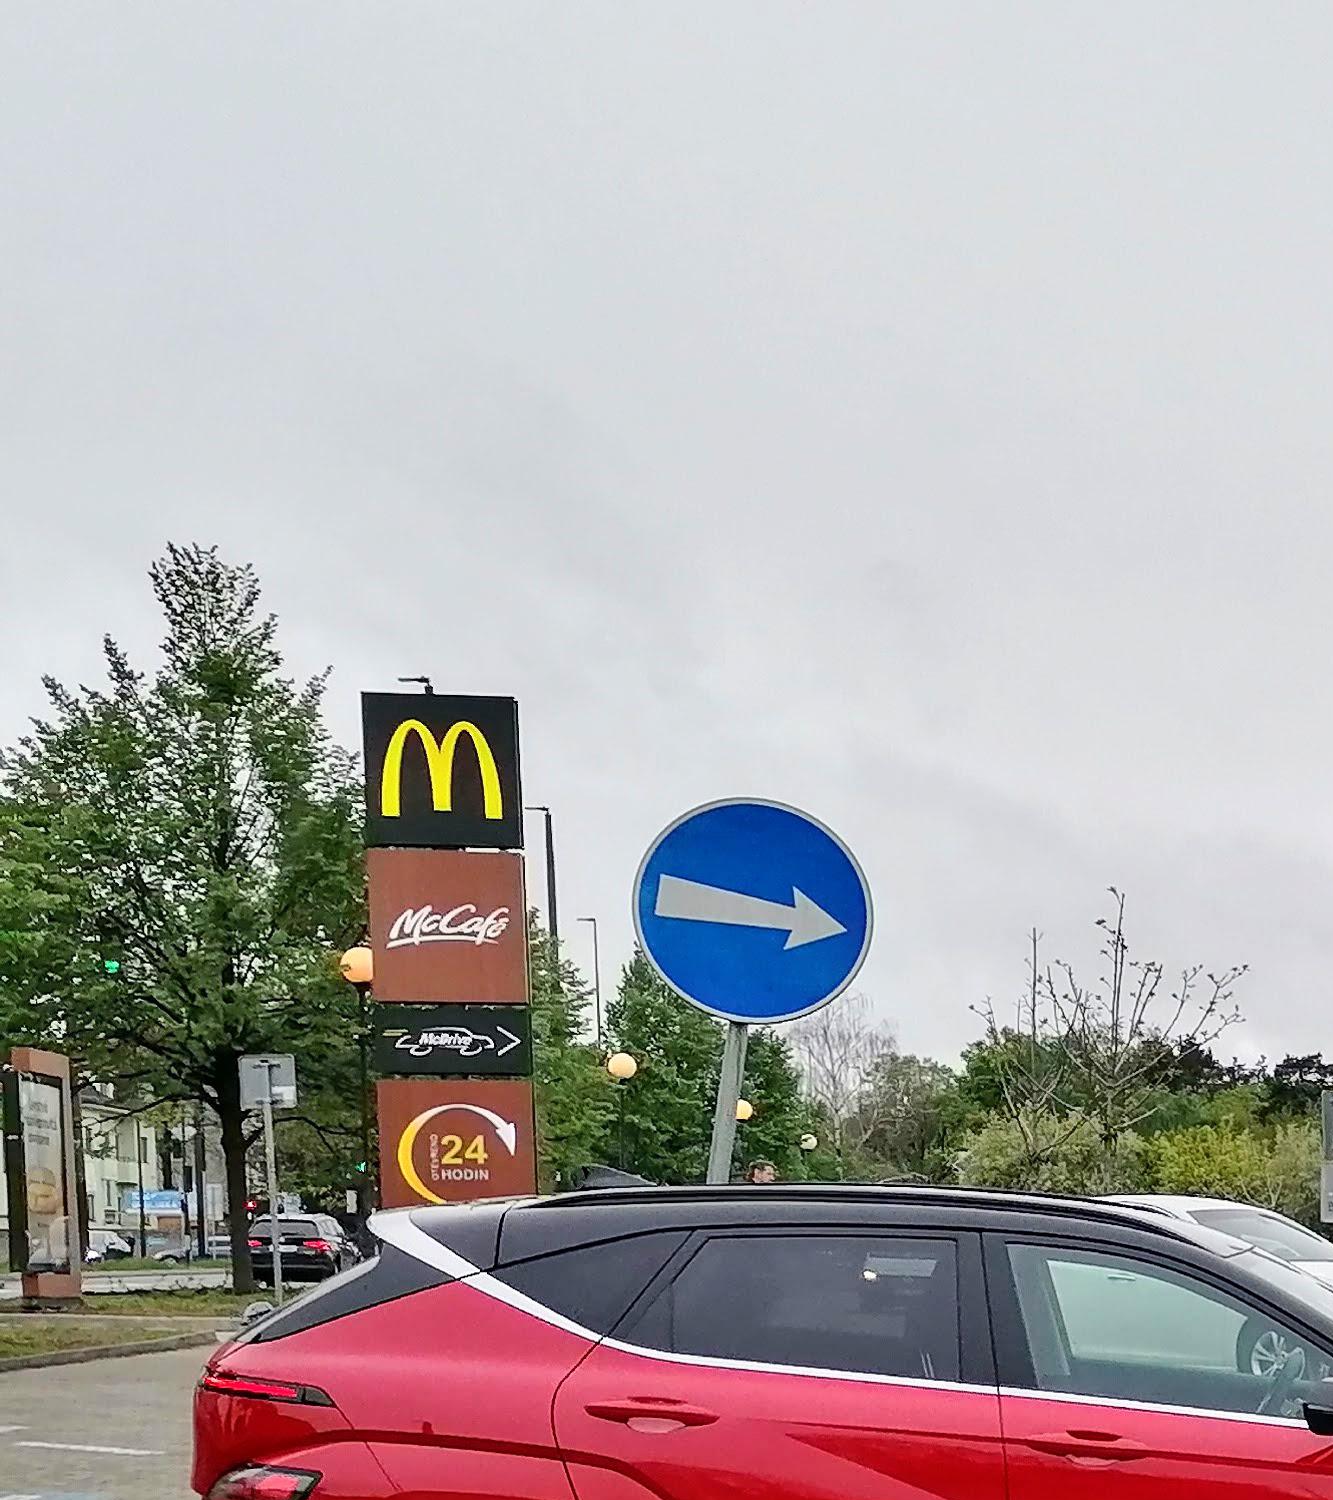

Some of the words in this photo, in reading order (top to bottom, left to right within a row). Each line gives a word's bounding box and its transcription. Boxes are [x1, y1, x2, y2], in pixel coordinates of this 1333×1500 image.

[387, 903, 510, 946] McCafé
[419, 1032, 473, 1046] McDrive
[441, 1134, 489, 1165] 24
[441, 1168, 490, 1181] HODIN
